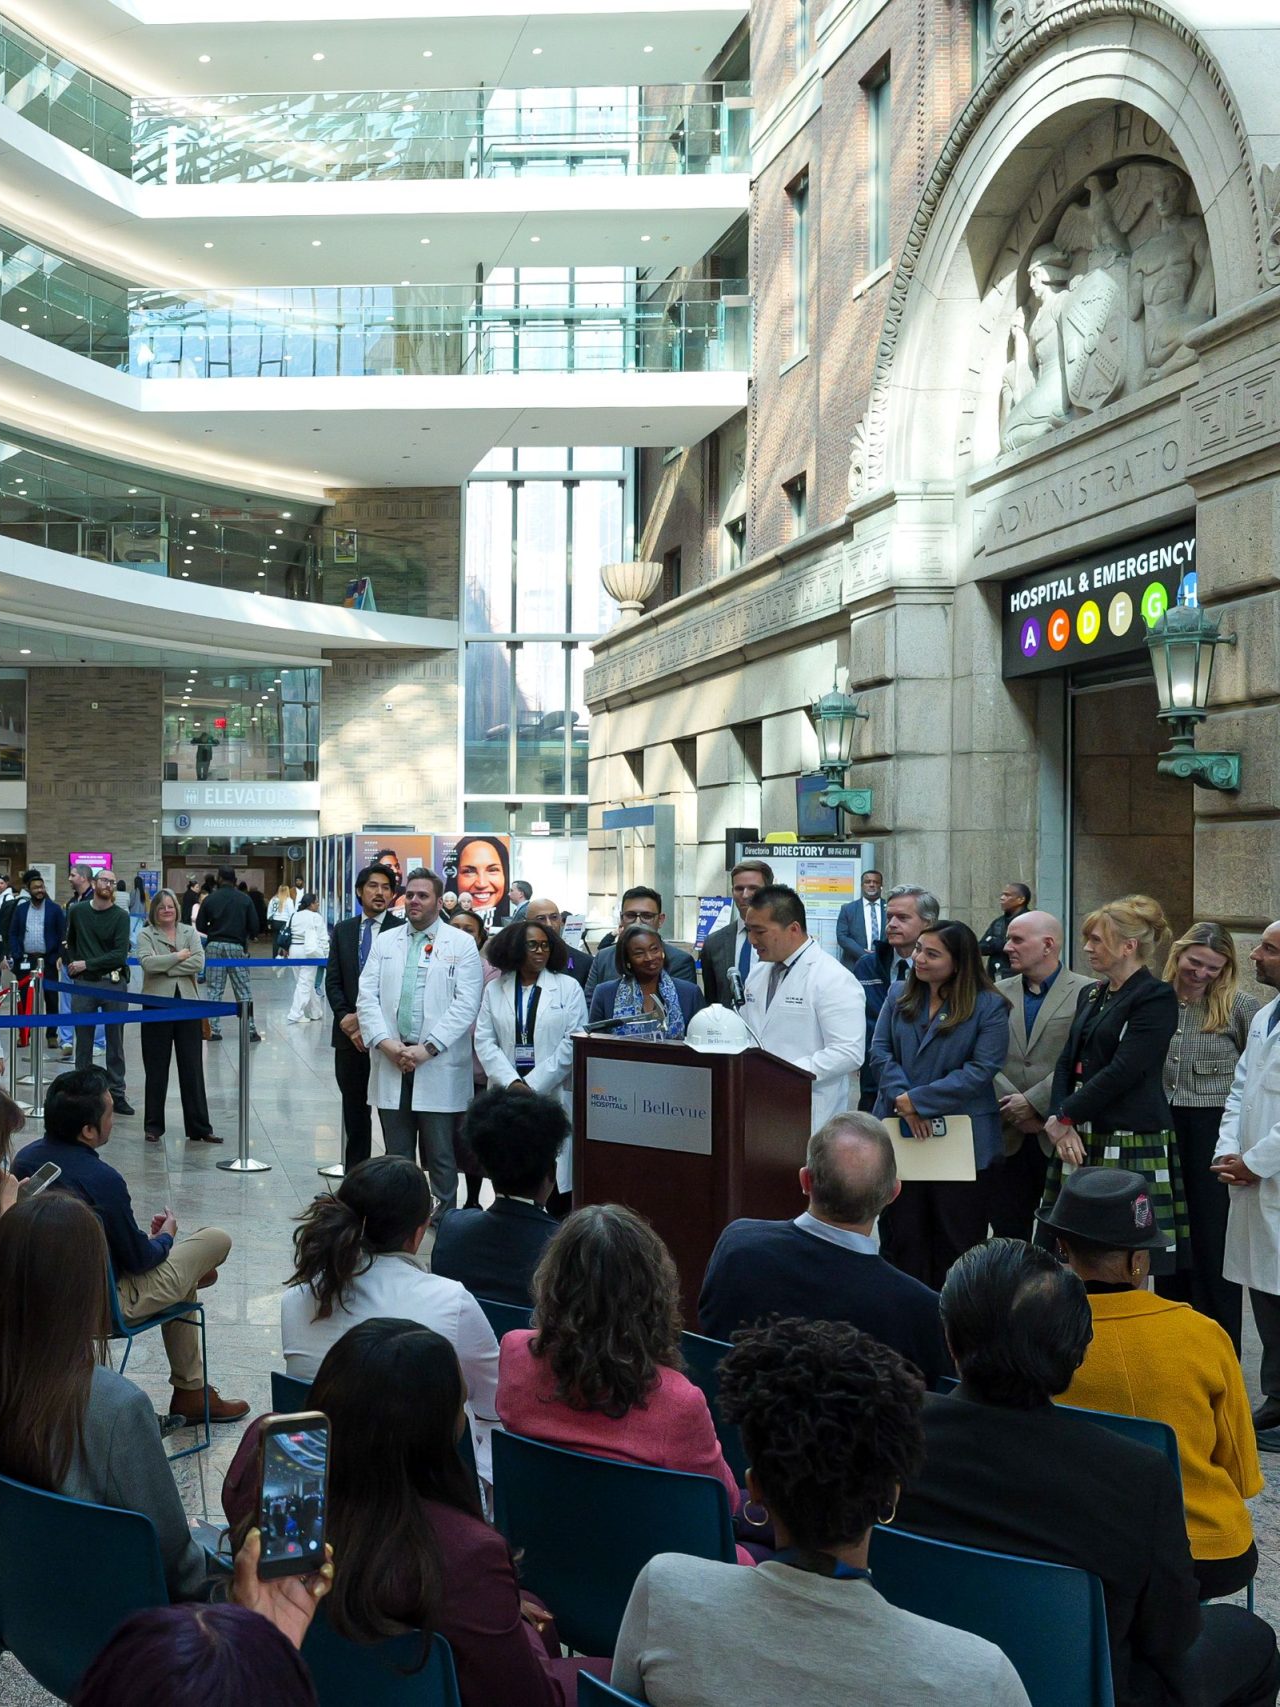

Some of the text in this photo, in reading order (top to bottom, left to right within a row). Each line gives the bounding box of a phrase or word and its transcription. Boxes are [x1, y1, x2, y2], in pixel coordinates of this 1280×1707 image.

[1010, 538, 1196, 613] HOSPITAL & EMERGENCY
[1024, 582, 1198, 649] A C D F G H
[744, 845, 825, 857] Directorio DIRECTORY
[591, 1101, 628, 1111] HOSPITALS
[642, 1099, 707, 1120] Bellevue
